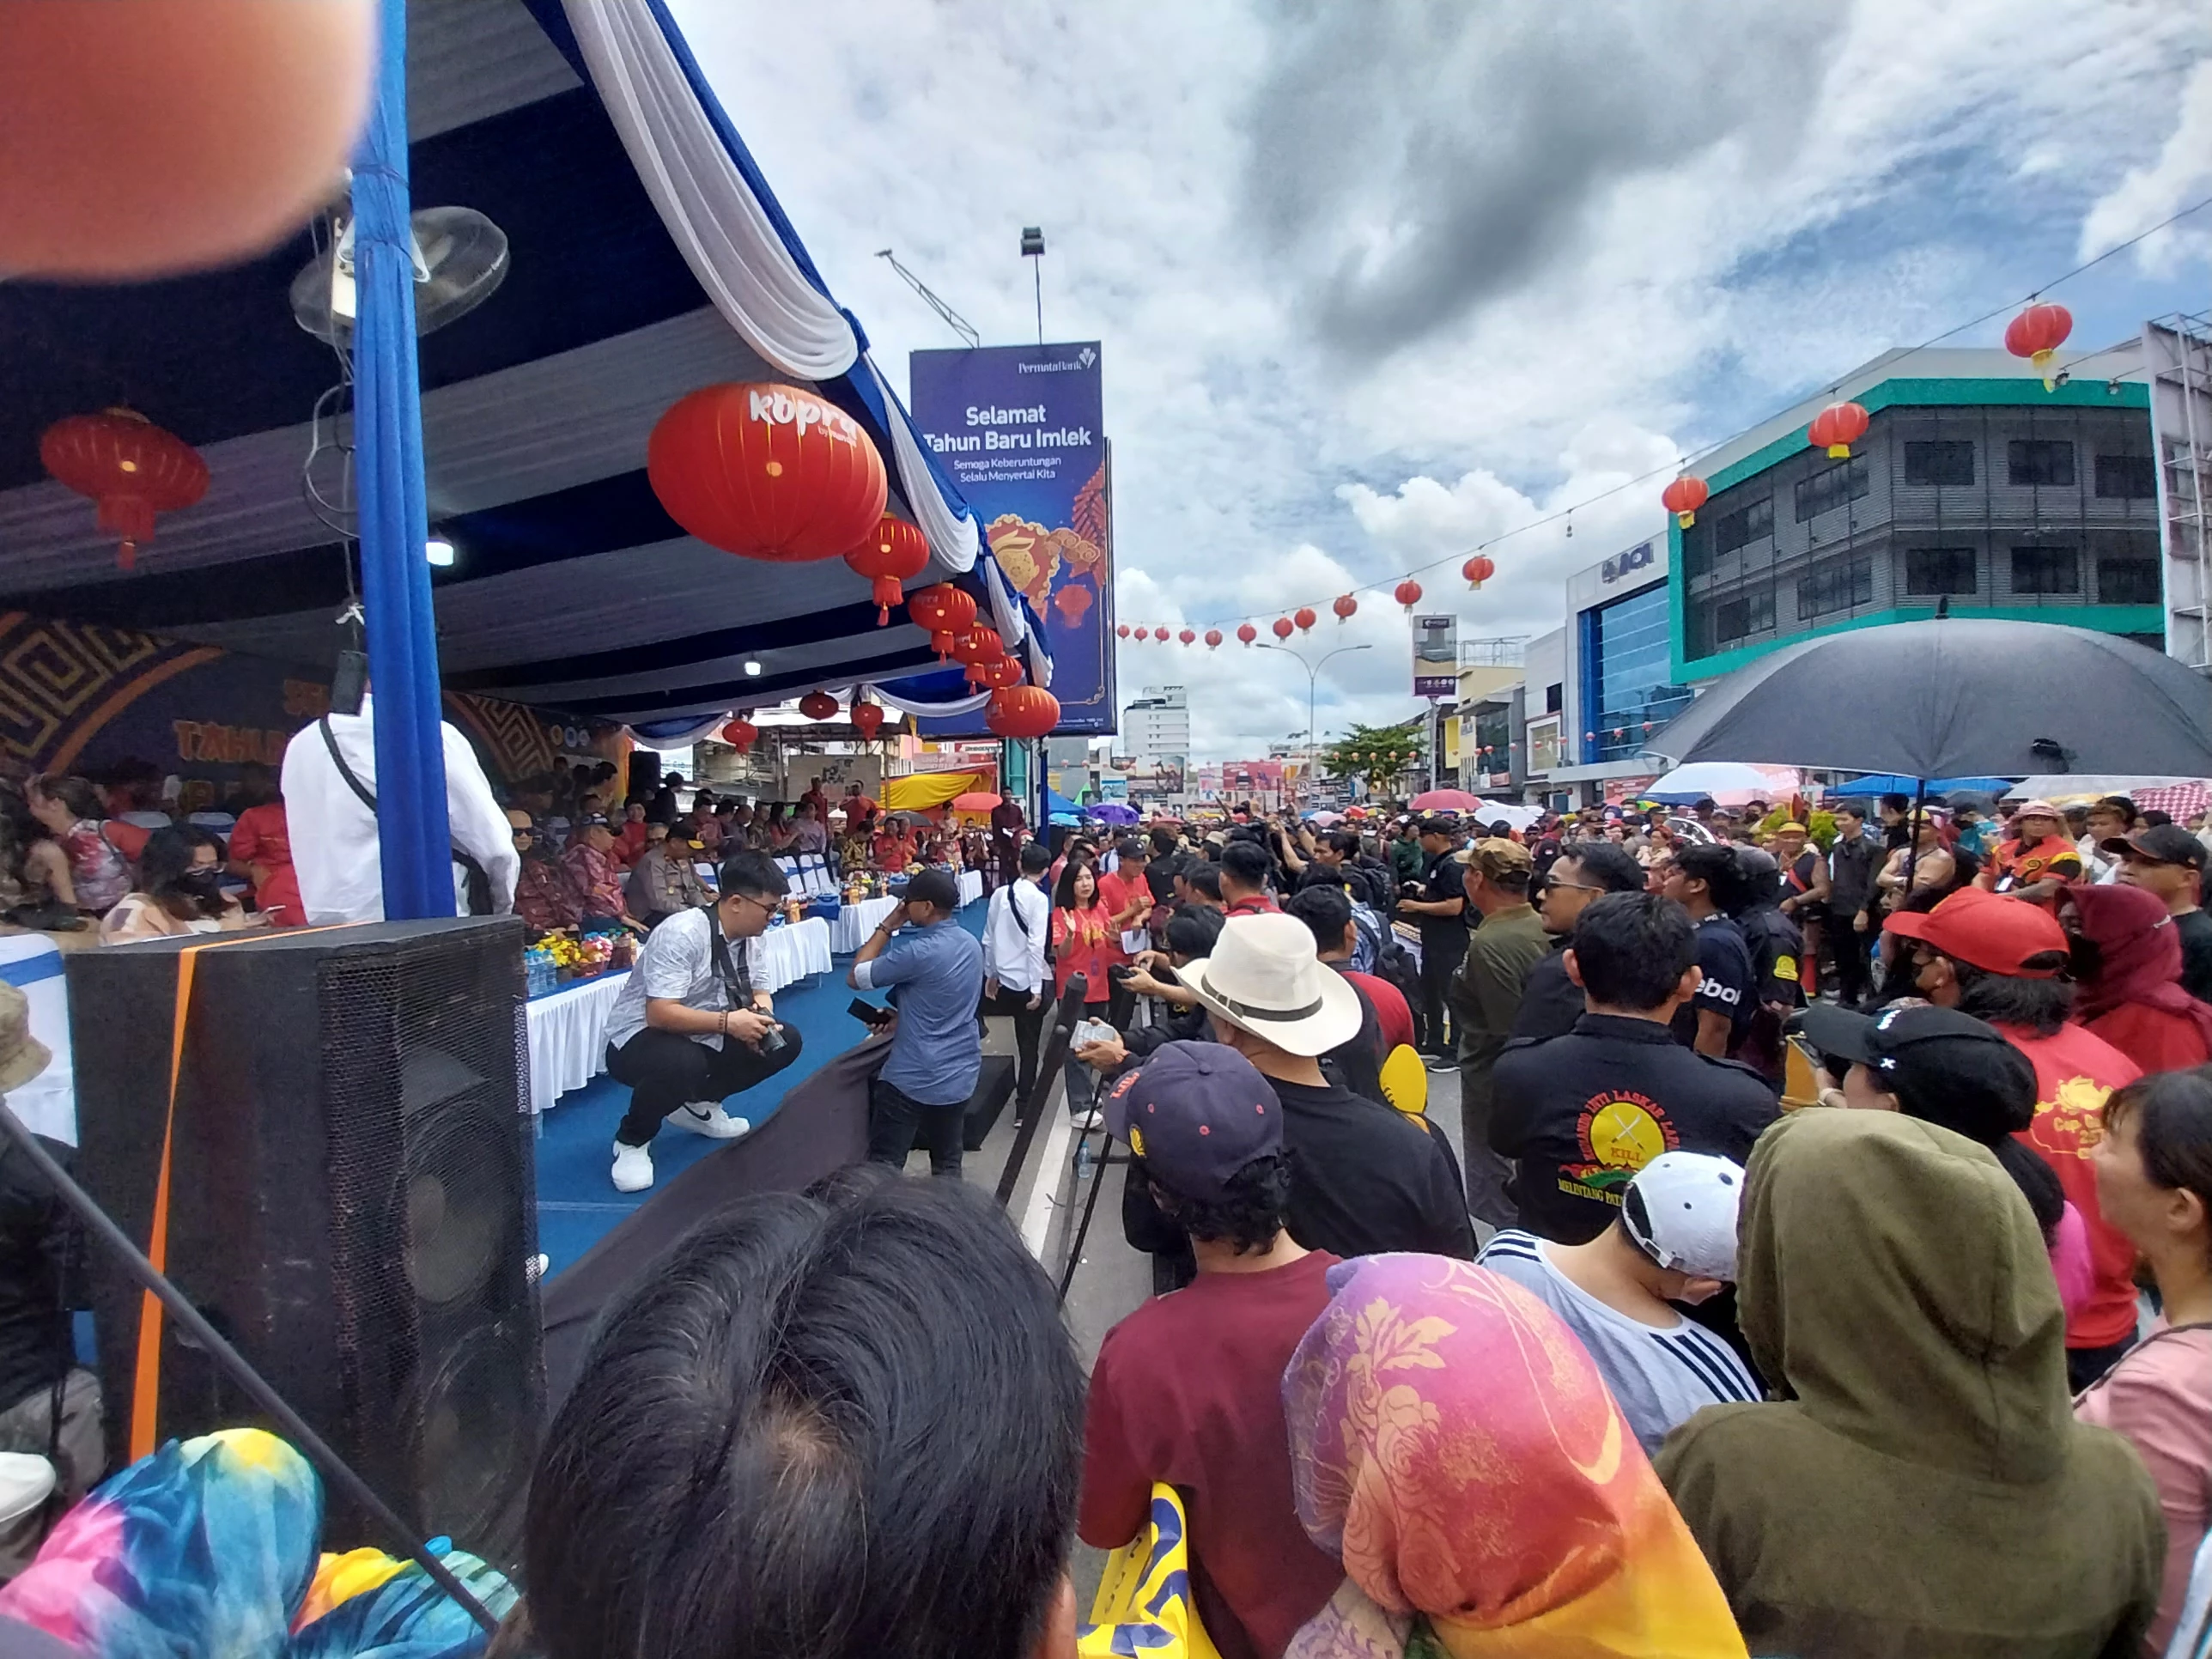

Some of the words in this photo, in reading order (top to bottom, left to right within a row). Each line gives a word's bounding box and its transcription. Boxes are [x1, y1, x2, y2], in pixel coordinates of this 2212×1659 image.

[965, 404, 1047, 427] Selamat
[923, 432, 981, 453] Tahun
[985, 430, 1031, 451] Baru
[1036, 425, 1092, 449] Imlek
[953, 459, 990, 471] Semoga
[991, 457, 1062, 468] Keberuntungan
[960, 471, 988, 483] Selalu
[988, 469, 1036, 482] Menyertai
[1036, 468, 1056, 479] Kita
[1610, 1146, 1644, 1163] KILL
